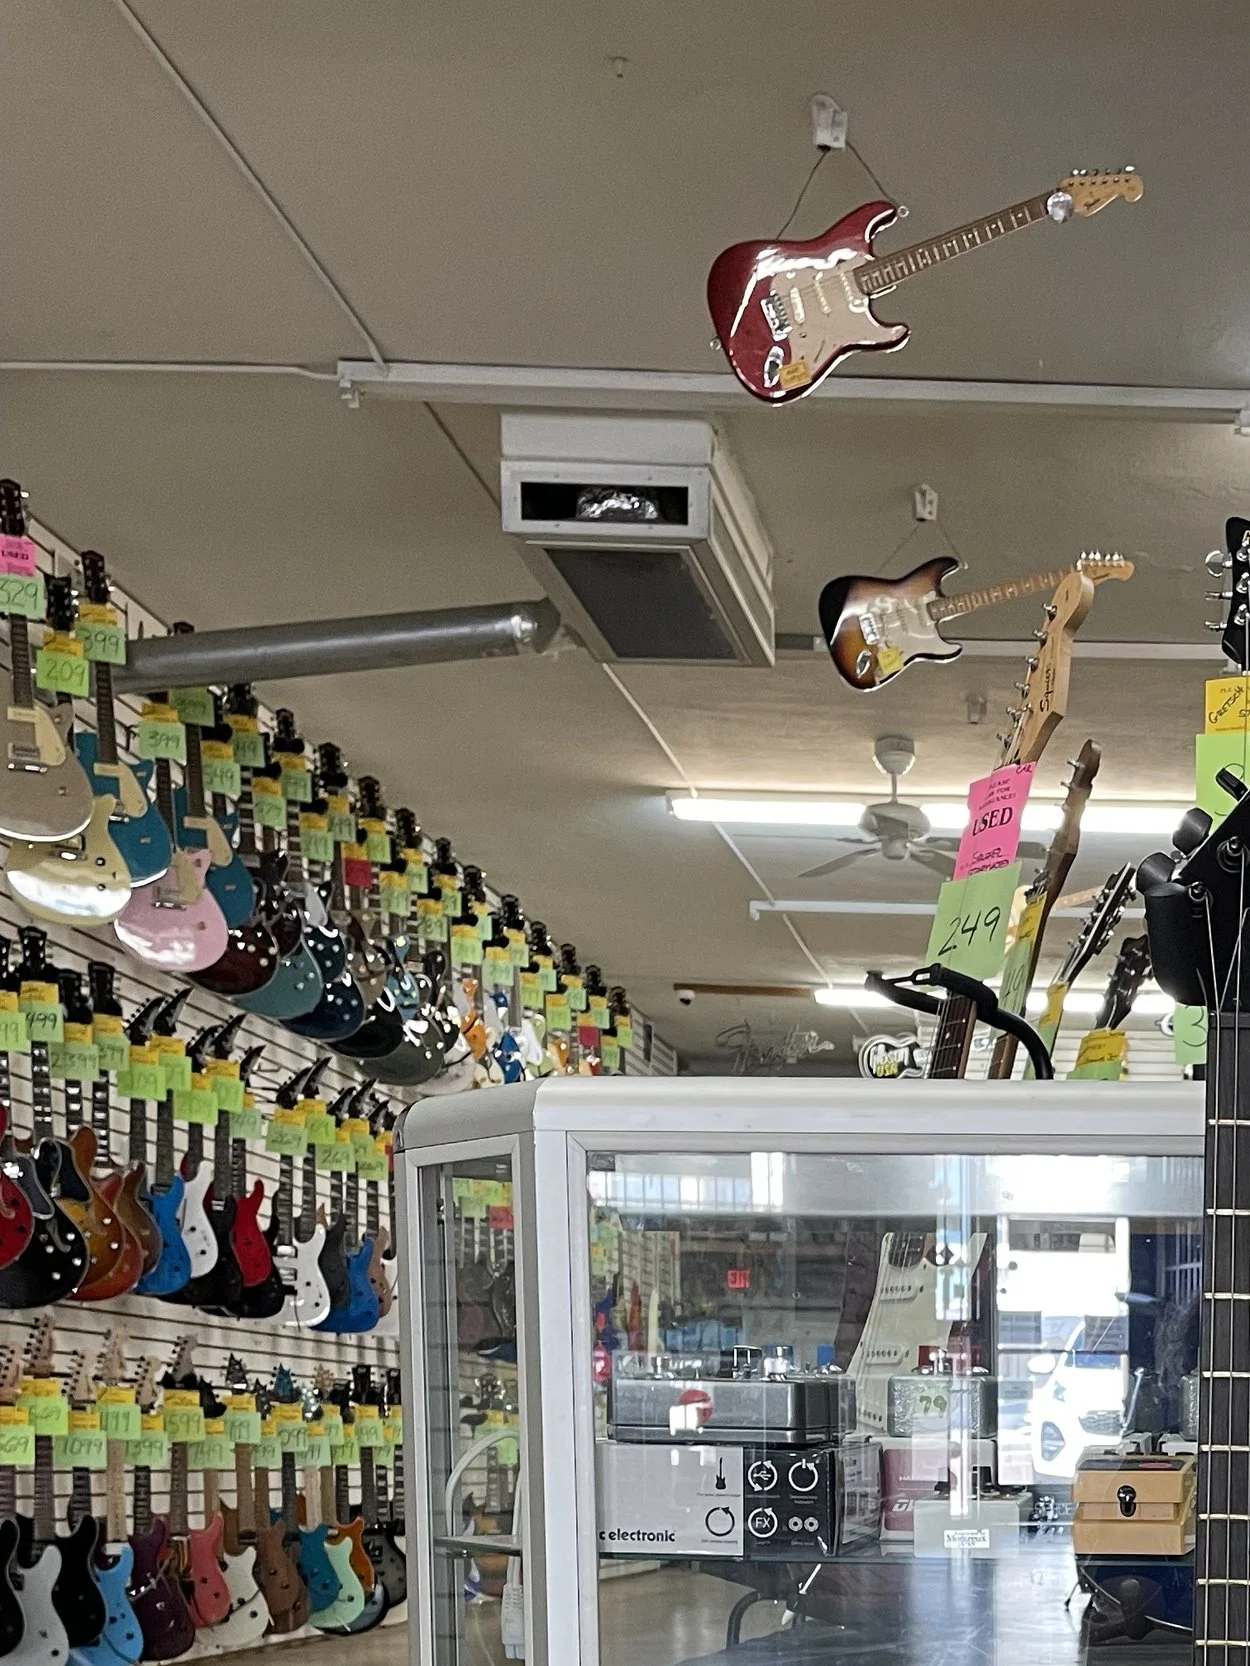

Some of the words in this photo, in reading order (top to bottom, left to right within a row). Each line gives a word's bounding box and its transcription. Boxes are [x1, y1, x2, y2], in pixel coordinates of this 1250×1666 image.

[47, 659, 85, 687] 209
[972, 806, 1014, 836] USED
[938, 906, 1001, 956] 249
[26, 1011, 58, 1031] 499
[755, 1517, 771, 1528] FX
[609, 1528, 676, 1543] electronic
